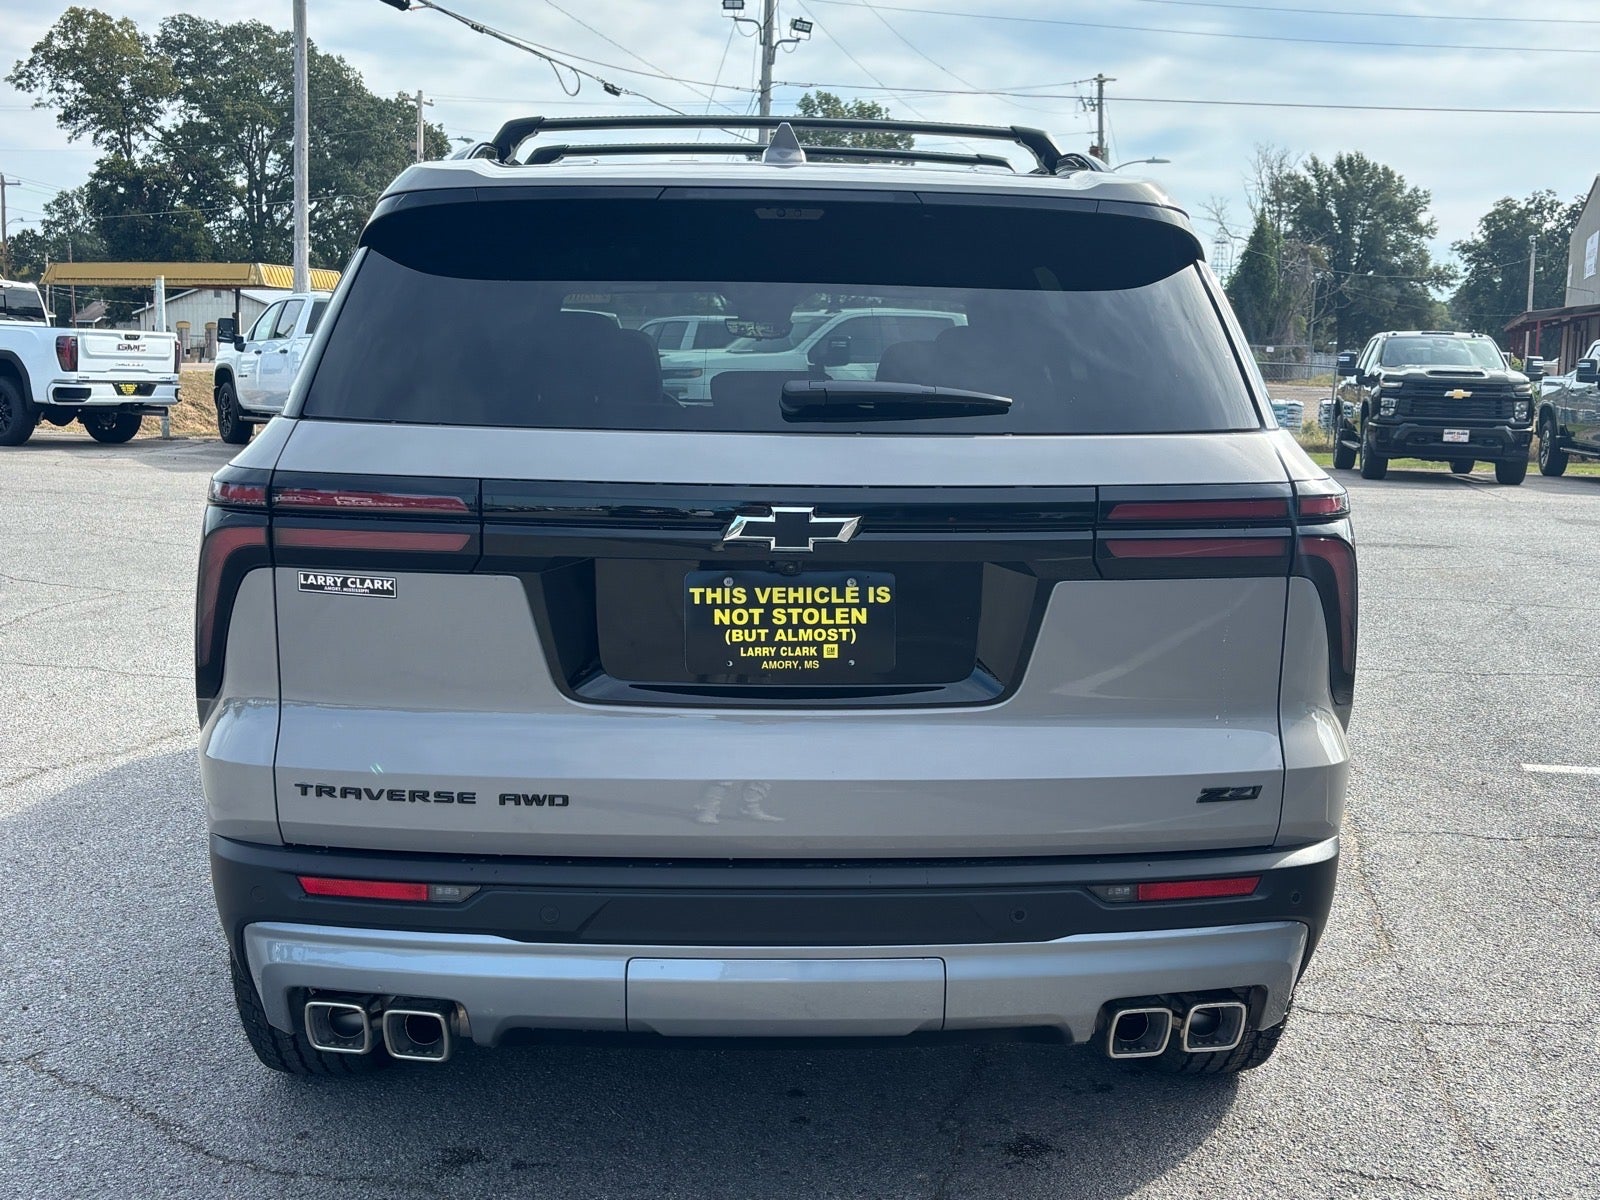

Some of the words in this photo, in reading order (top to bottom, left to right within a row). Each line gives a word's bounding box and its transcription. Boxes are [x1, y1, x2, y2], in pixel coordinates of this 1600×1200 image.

[300, 574, 343, 586] LARRY
[347, 578, 394, 590] CLARK
[689, 587, 747, 604] THIS
[755, 586, 859, 604] VEHICLE
[868, 586, 891, 603] IS
[714, 608, 764, 625] NOT
[772, 608, 867, 625] STOLEN
[725, 628, 769, 645] (BUT
[775, 628, 857, 644] ALMOST)
[740, 647, 777, 657] LARRY
[780, 646, 817, 657] CLARK
[761, 660, 802, 670] AMORY,
[804, 660, 820, 669] MS
[294, 783, 477, 805] TRAVERSE
[498, 792, 570, 807] AWD
[1196, 785, 1263, 803] Z71
